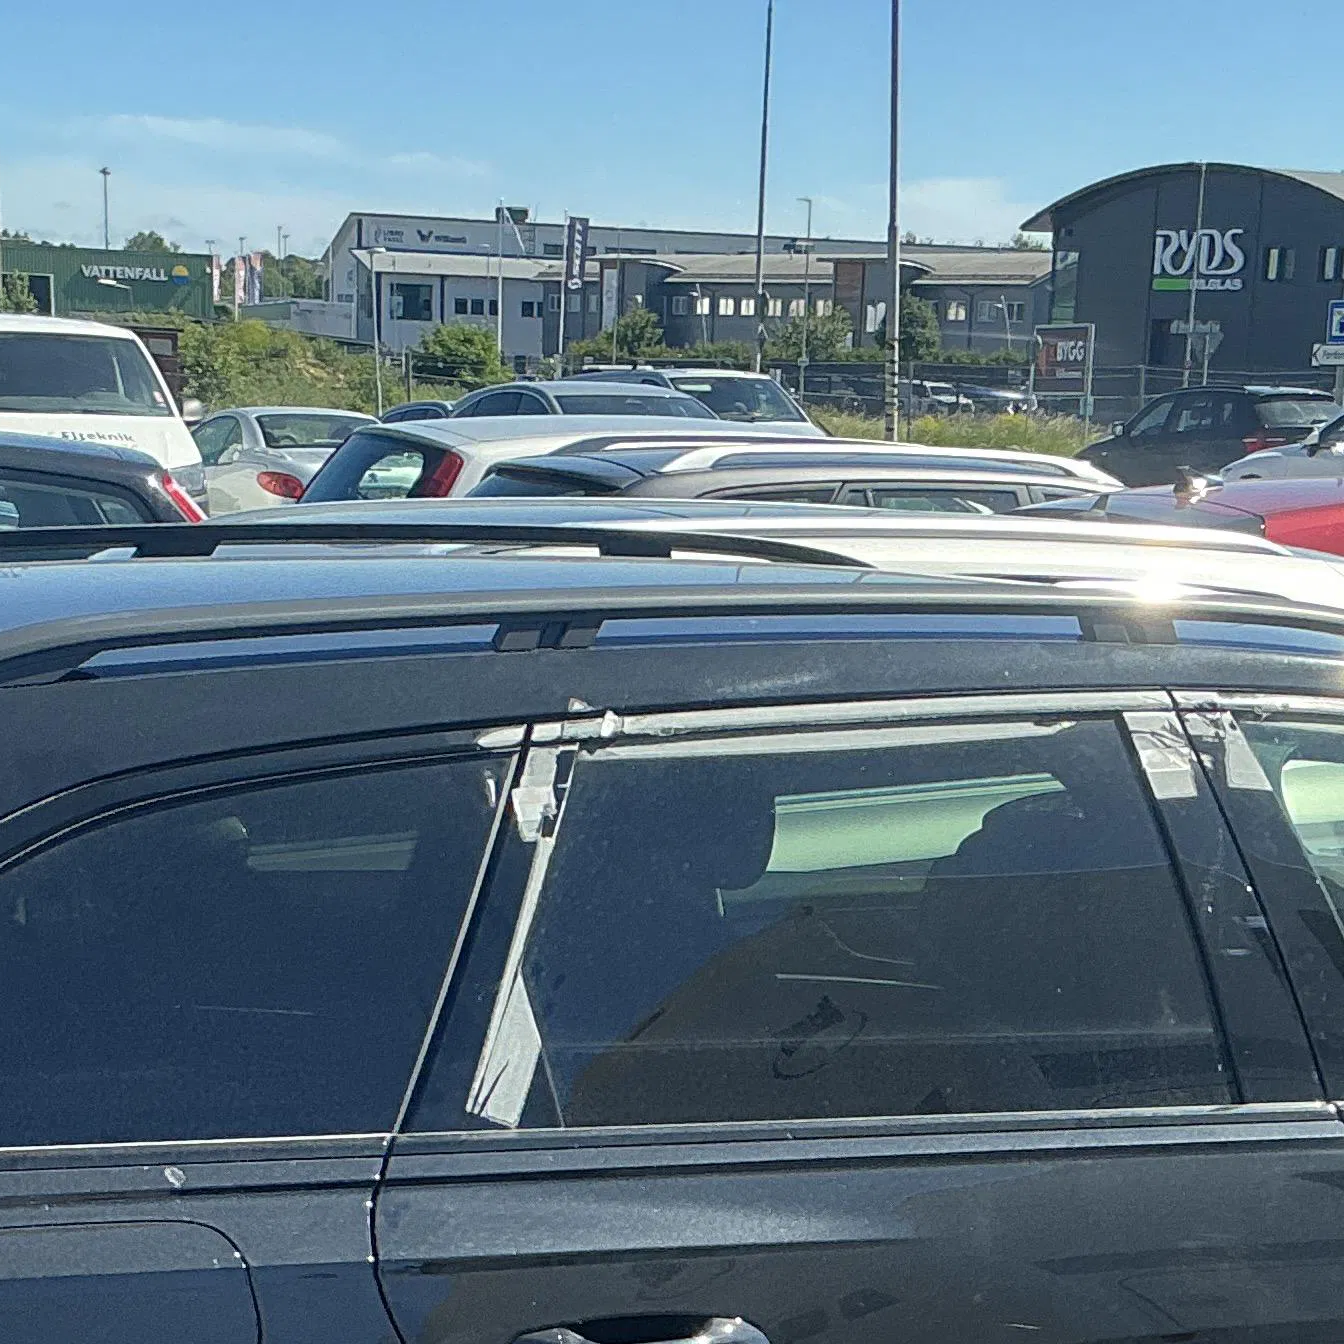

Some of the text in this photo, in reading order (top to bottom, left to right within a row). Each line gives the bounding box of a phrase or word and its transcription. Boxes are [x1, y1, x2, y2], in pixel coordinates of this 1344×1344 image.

[1153, 229, 1244, 275] RYDS
[81, 264, 168, 281] VATTENFALL
[1057, 341, 1085, 361] BYGG
